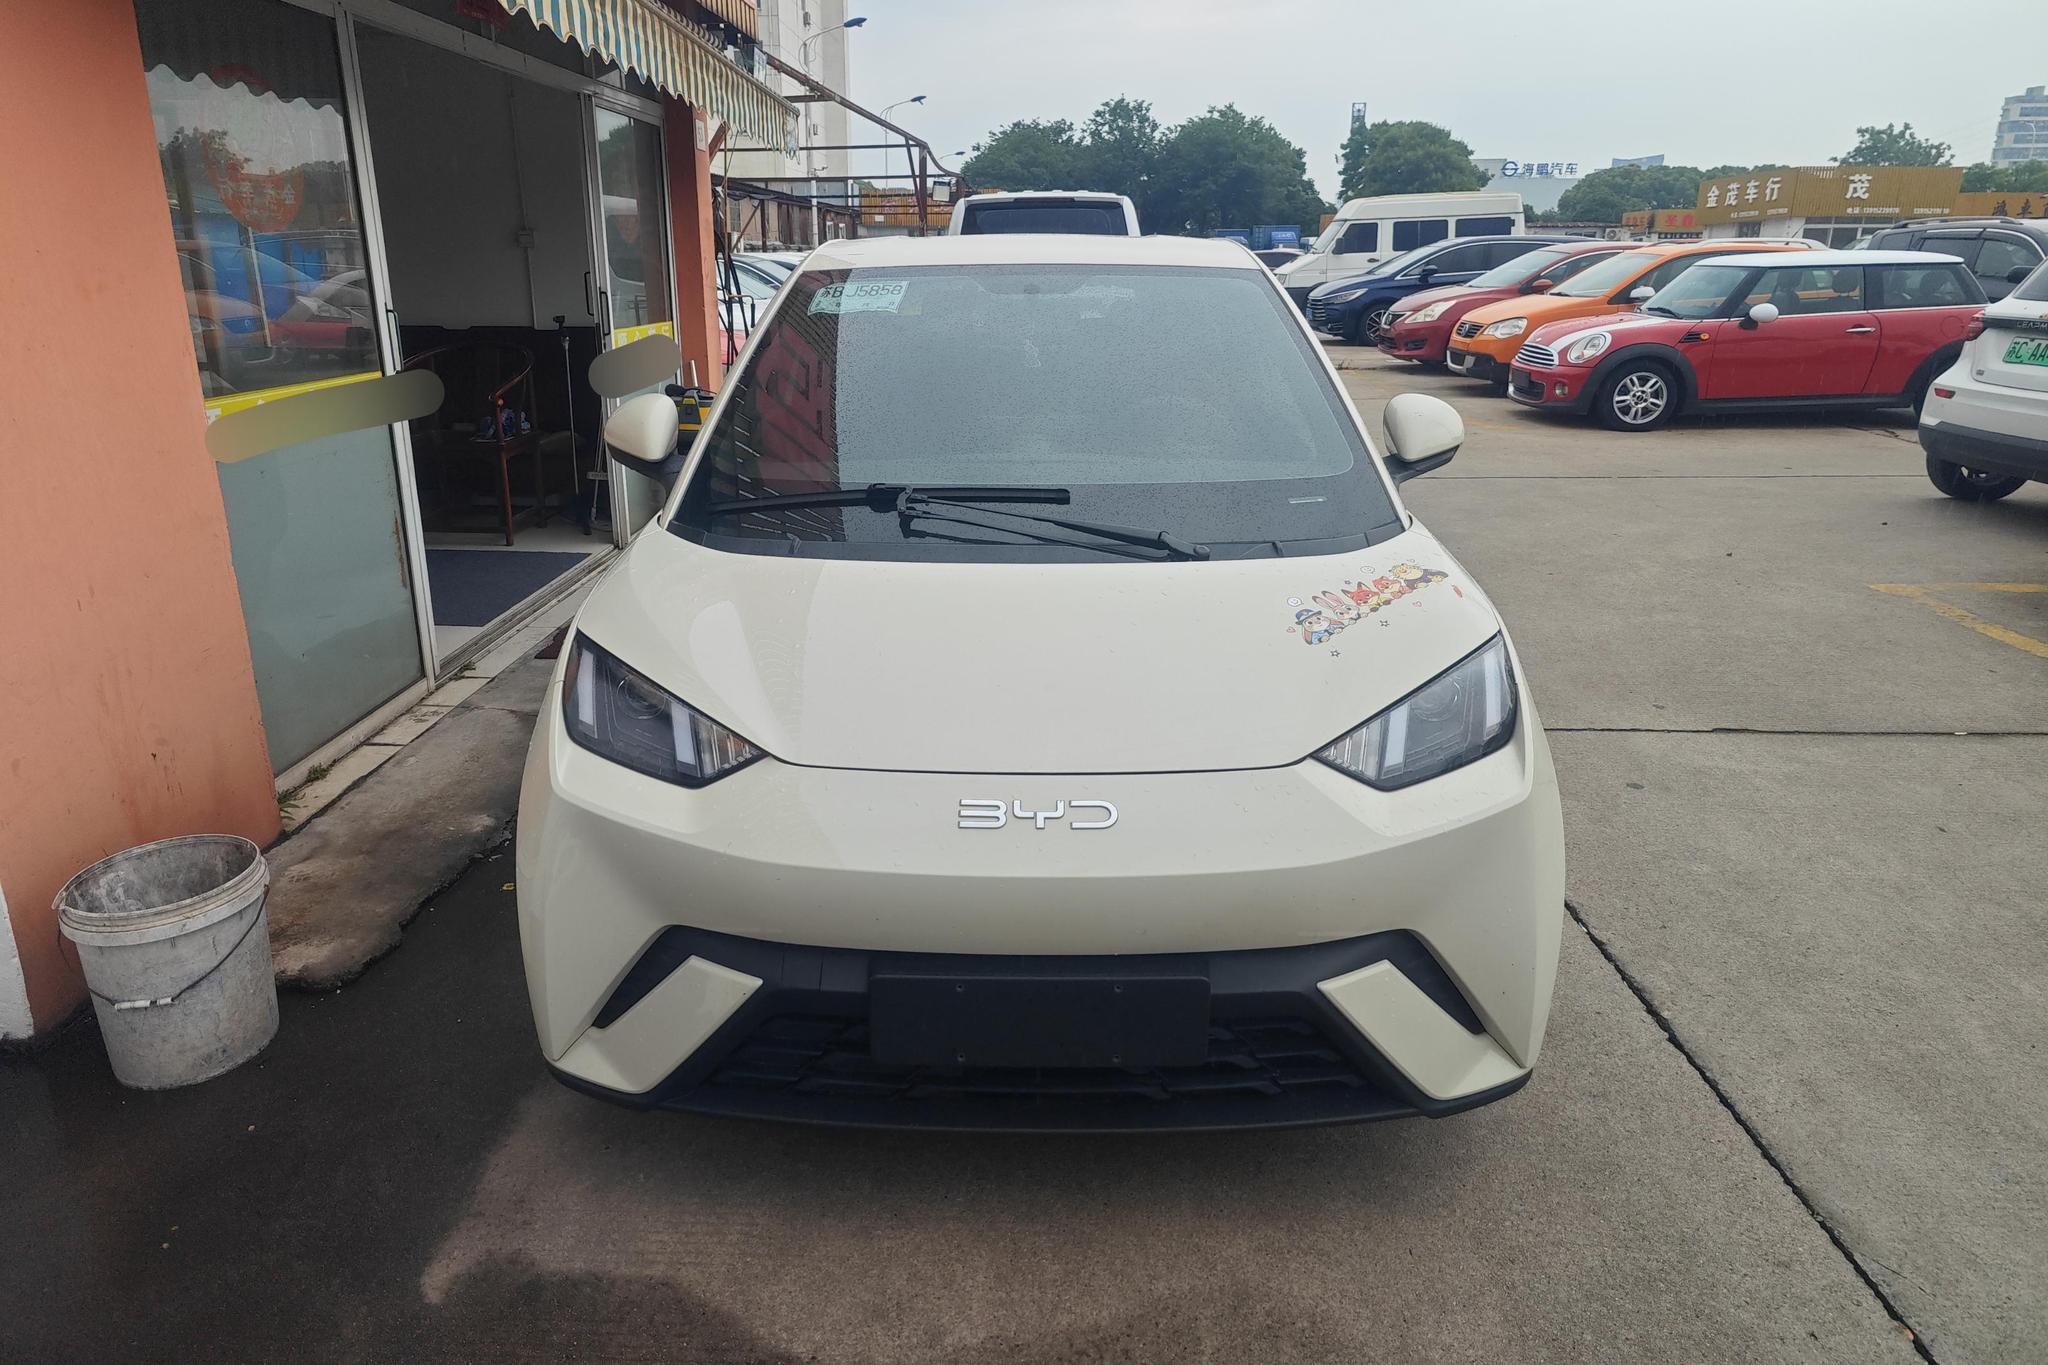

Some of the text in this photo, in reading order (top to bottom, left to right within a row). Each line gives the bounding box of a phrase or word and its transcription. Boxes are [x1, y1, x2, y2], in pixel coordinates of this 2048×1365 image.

[1521, 163, 1579, 176] 海鹏汽车
[1705, 177, 1782, 208] 金茂车行
[1844, 174, 1872, 199] 茂
[958, 799, 1119, 831] BYD
